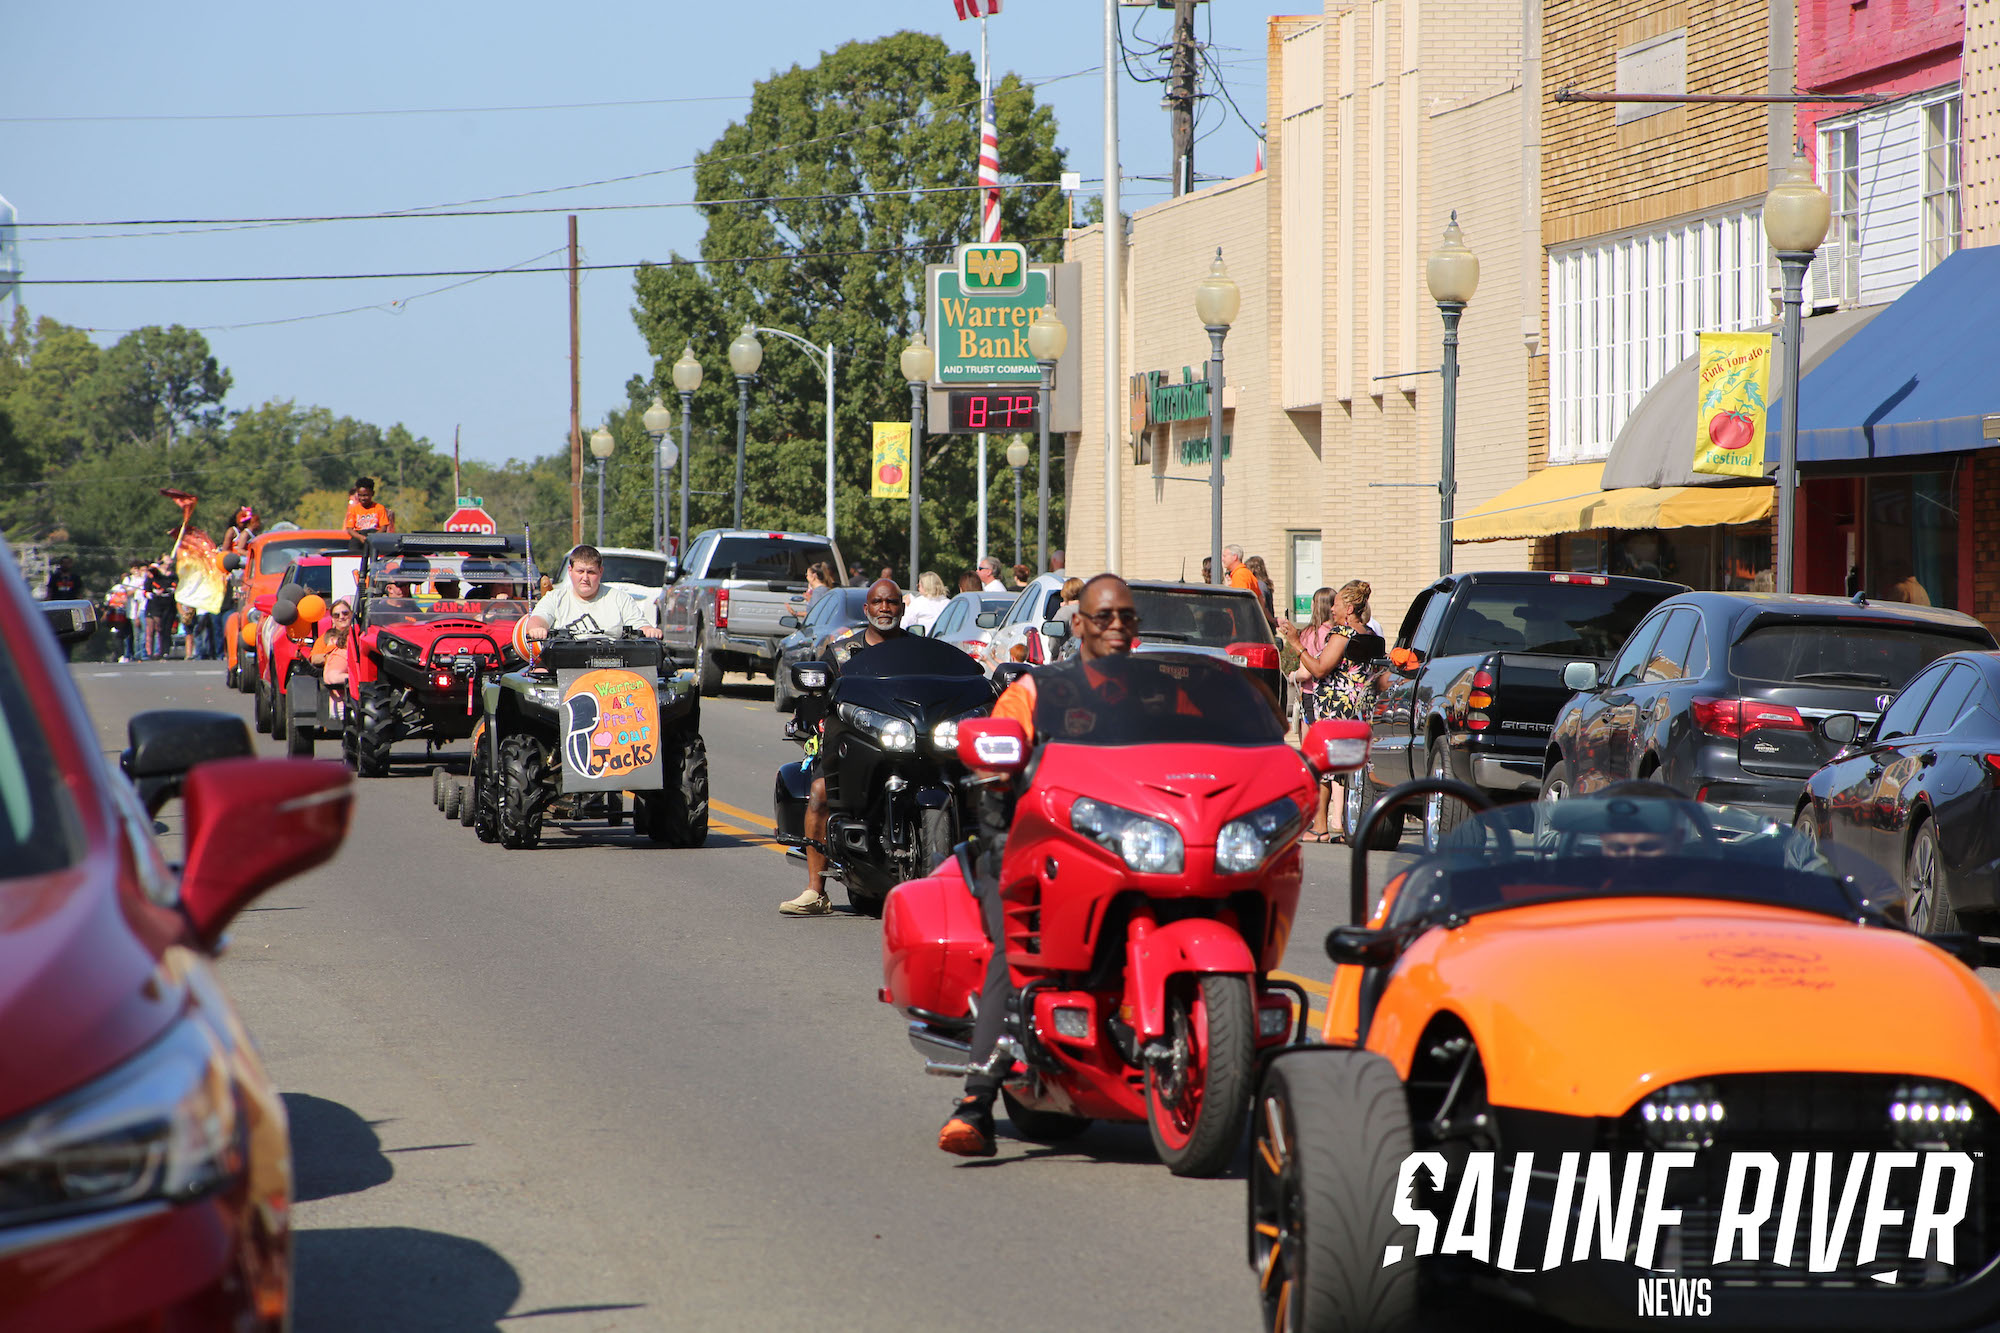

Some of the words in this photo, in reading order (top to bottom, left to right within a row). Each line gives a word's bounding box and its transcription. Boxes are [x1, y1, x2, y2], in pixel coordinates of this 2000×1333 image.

[957, 329, 1029, 358] Bank
[943, 366, 963, 374] AND
[965, 366, 995, 374] TRUST
[1701, 362, 1725, 383] Pink
[1725, 347, 1763, 369] Tomato
[1706, 451, 1753, 467] Festival
[433, 602, 481, 613] CAN-AM
[595, 680, 644, 697] Warren
[612, 694, 635, 709] ABC
[618, 726, 650, 745] our
